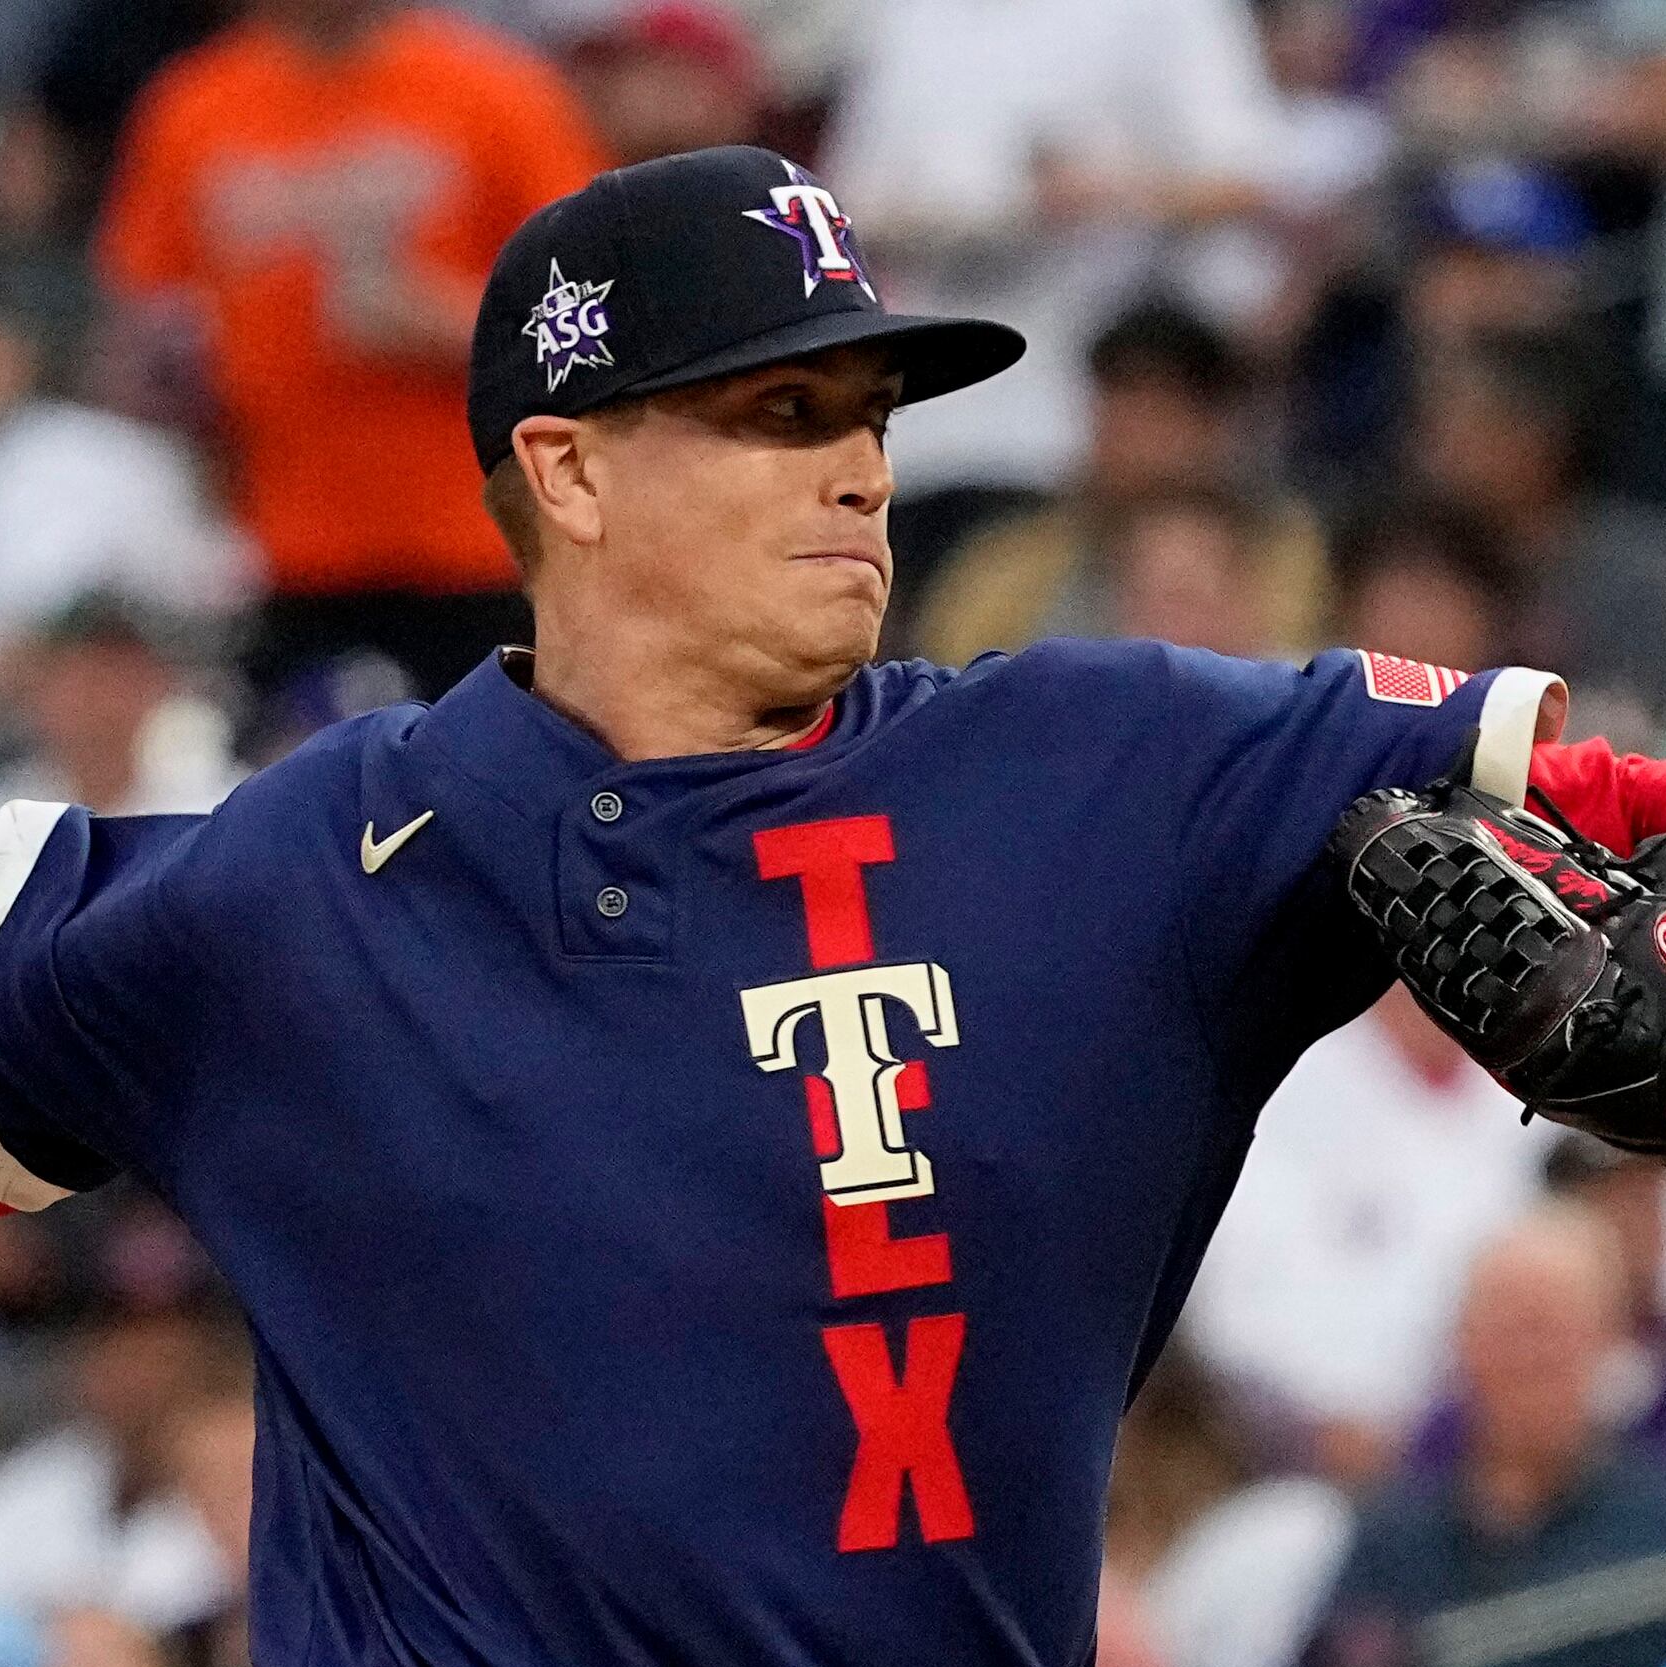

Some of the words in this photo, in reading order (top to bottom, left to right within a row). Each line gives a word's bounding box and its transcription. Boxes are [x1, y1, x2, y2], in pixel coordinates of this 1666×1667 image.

[769, 185, 858, 281] T
[537, 299, 610, 364] ASG
[740, 962, 960, 1207] T
